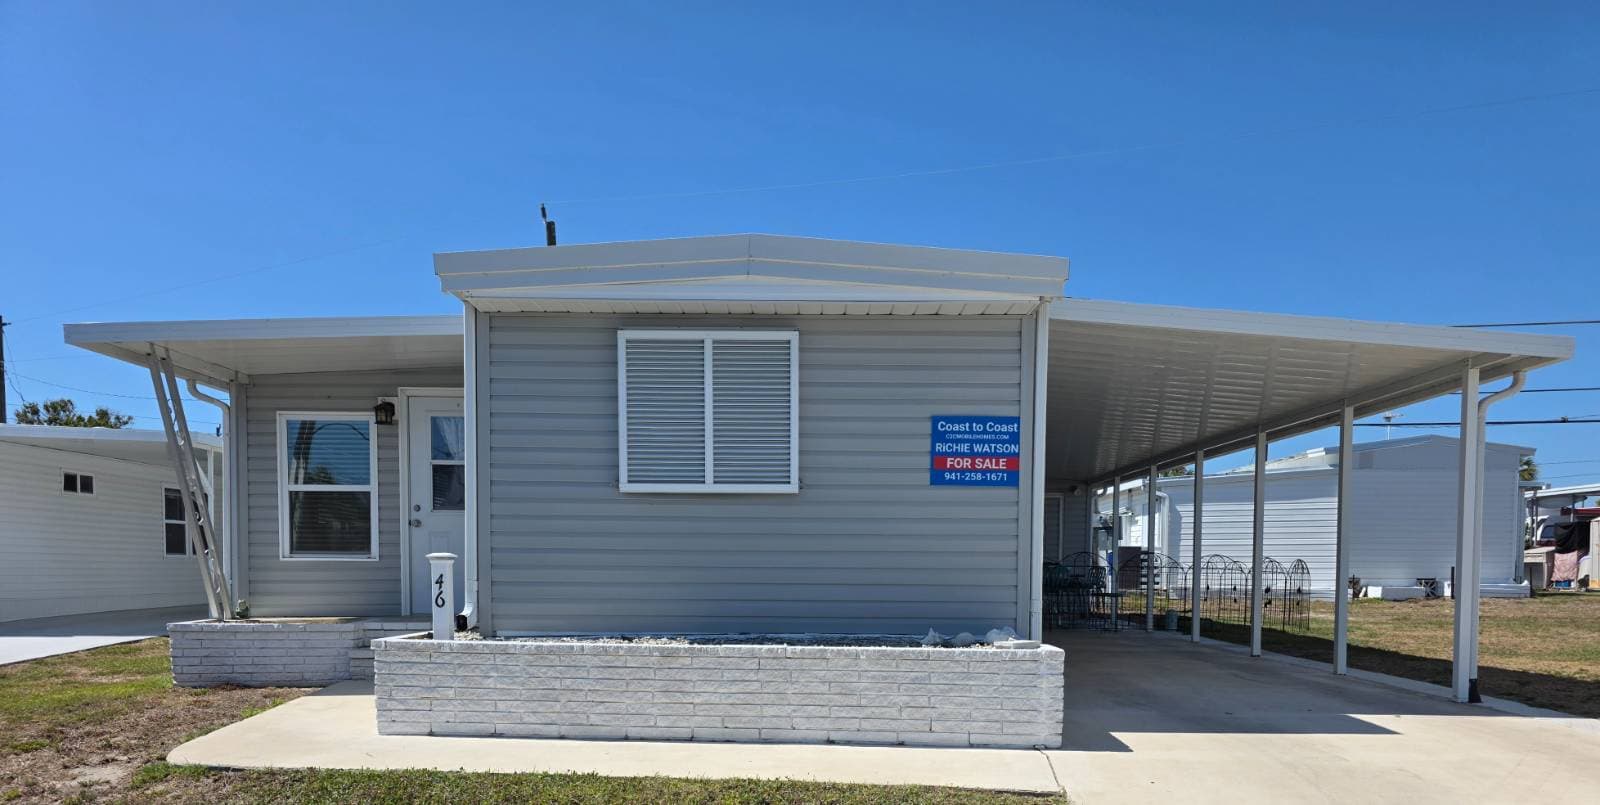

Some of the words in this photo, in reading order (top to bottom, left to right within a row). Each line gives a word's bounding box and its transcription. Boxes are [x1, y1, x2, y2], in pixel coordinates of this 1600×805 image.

[938, 421, 970, 431] Coast
[972, 422, 983, 431] to
[986, 422, 1018, 432] Coast
[973, 443, 1018, 453] WATSON
[946, 457, 971, 469] FOR
[974, 458, 1007, 469] SALE
[944, 472, 1007, 481] 941-258-1671
